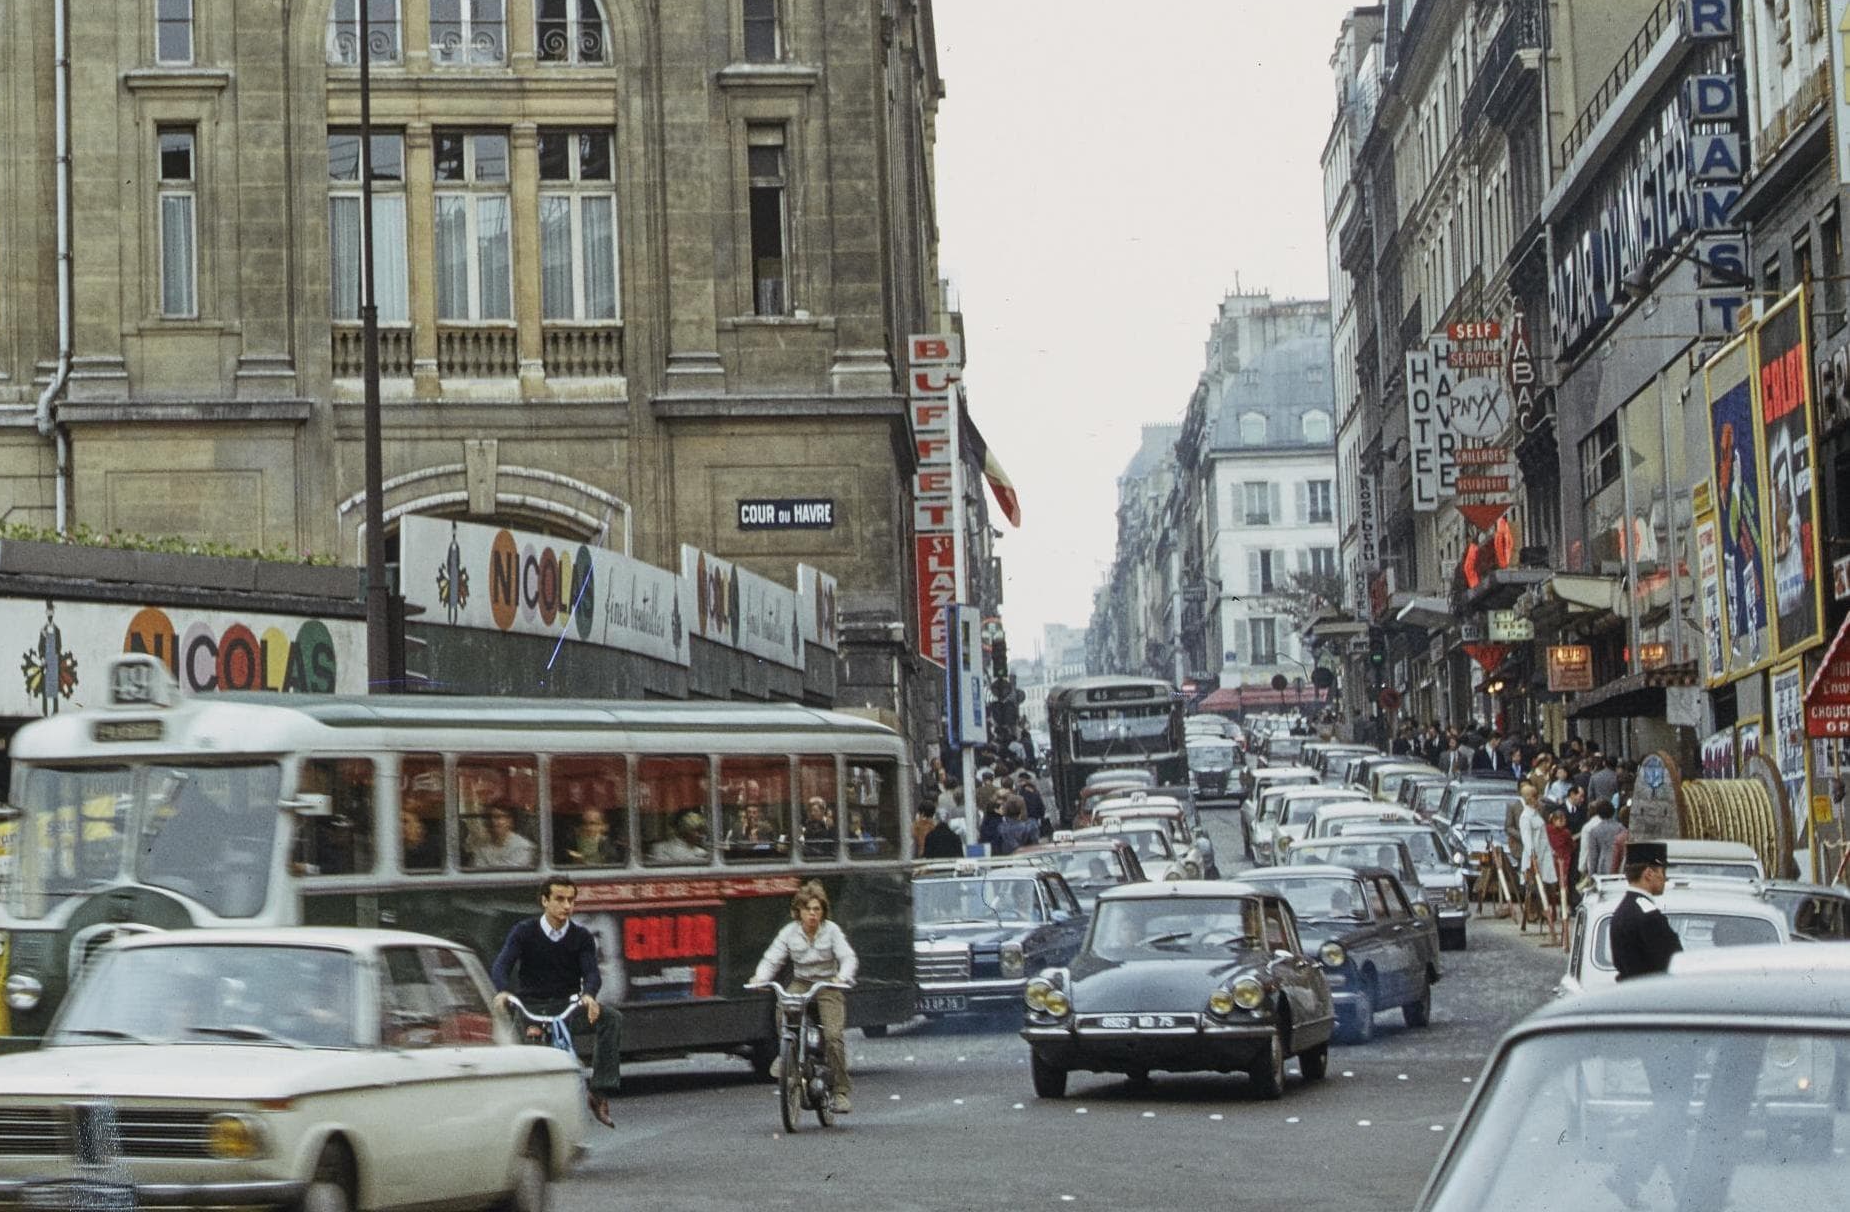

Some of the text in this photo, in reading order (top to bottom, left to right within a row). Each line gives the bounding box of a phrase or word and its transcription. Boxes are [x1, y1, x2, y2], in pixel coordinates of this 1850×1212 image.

[1456, 323, 1492, 339] SELF
[1550, 229, 1597, 364] BAZAR
[1451, 351, 1500, 366] SERVICE
[1512, 313, 1535, 433] TABAC
[914, 340, 954, 526] BUFFET
[1411, 358, 1434, 503] HOTEL
[1434, 344, 1455, 488] HAVRE
[741, 503, 832, 524] COUR DU HAVRE
[493, 549, 593, 616] NICOLAS
[928, 555, 955, 659] LAZARE
[130, 631, 336, 693] NICOLAS
